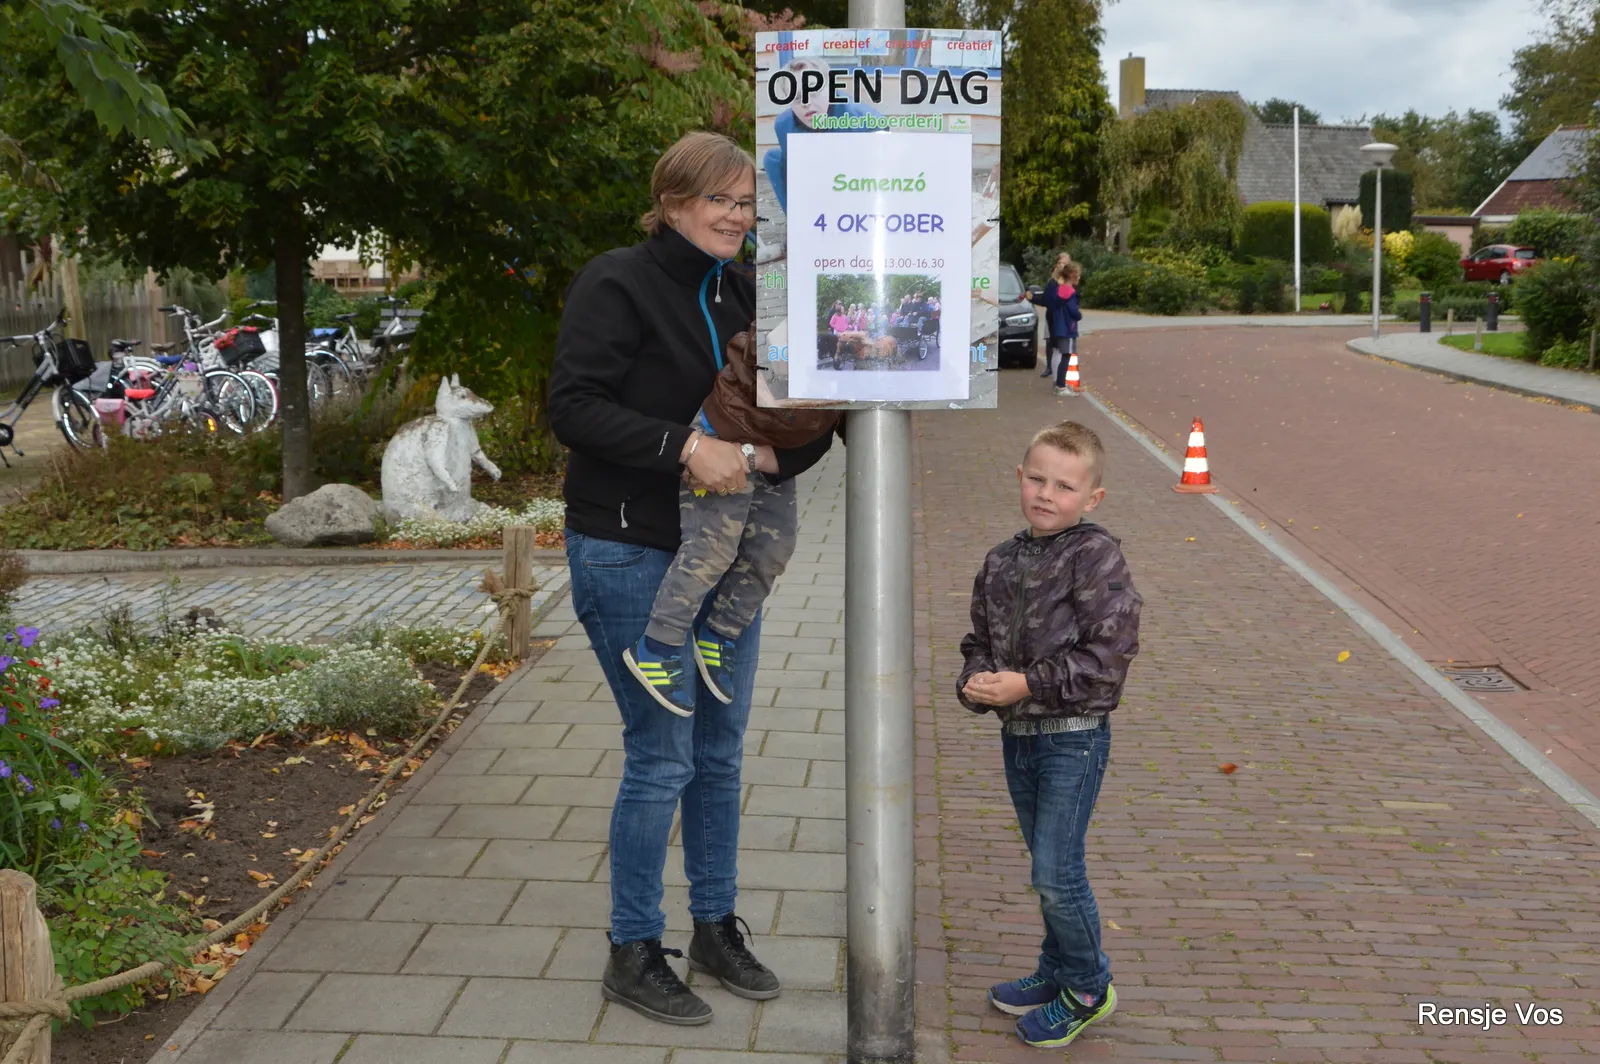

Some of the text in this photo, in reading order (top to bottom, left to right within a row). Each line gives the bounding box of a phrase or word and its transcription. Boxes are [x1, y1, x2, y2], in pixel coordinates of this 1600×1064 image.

[765, 38, 993, 51] creatief creatief creatief creatief
[767, 69, 989, 106] OPEN DAG
[812, 113, 943, 131] Kinderboerderij
[832, 171, 927, 193] Samenzó
[813, 213, 945, 234] 4 OKTOBER
[814, 258, 845, 271] open
[849, 255, 874, 272] dag
